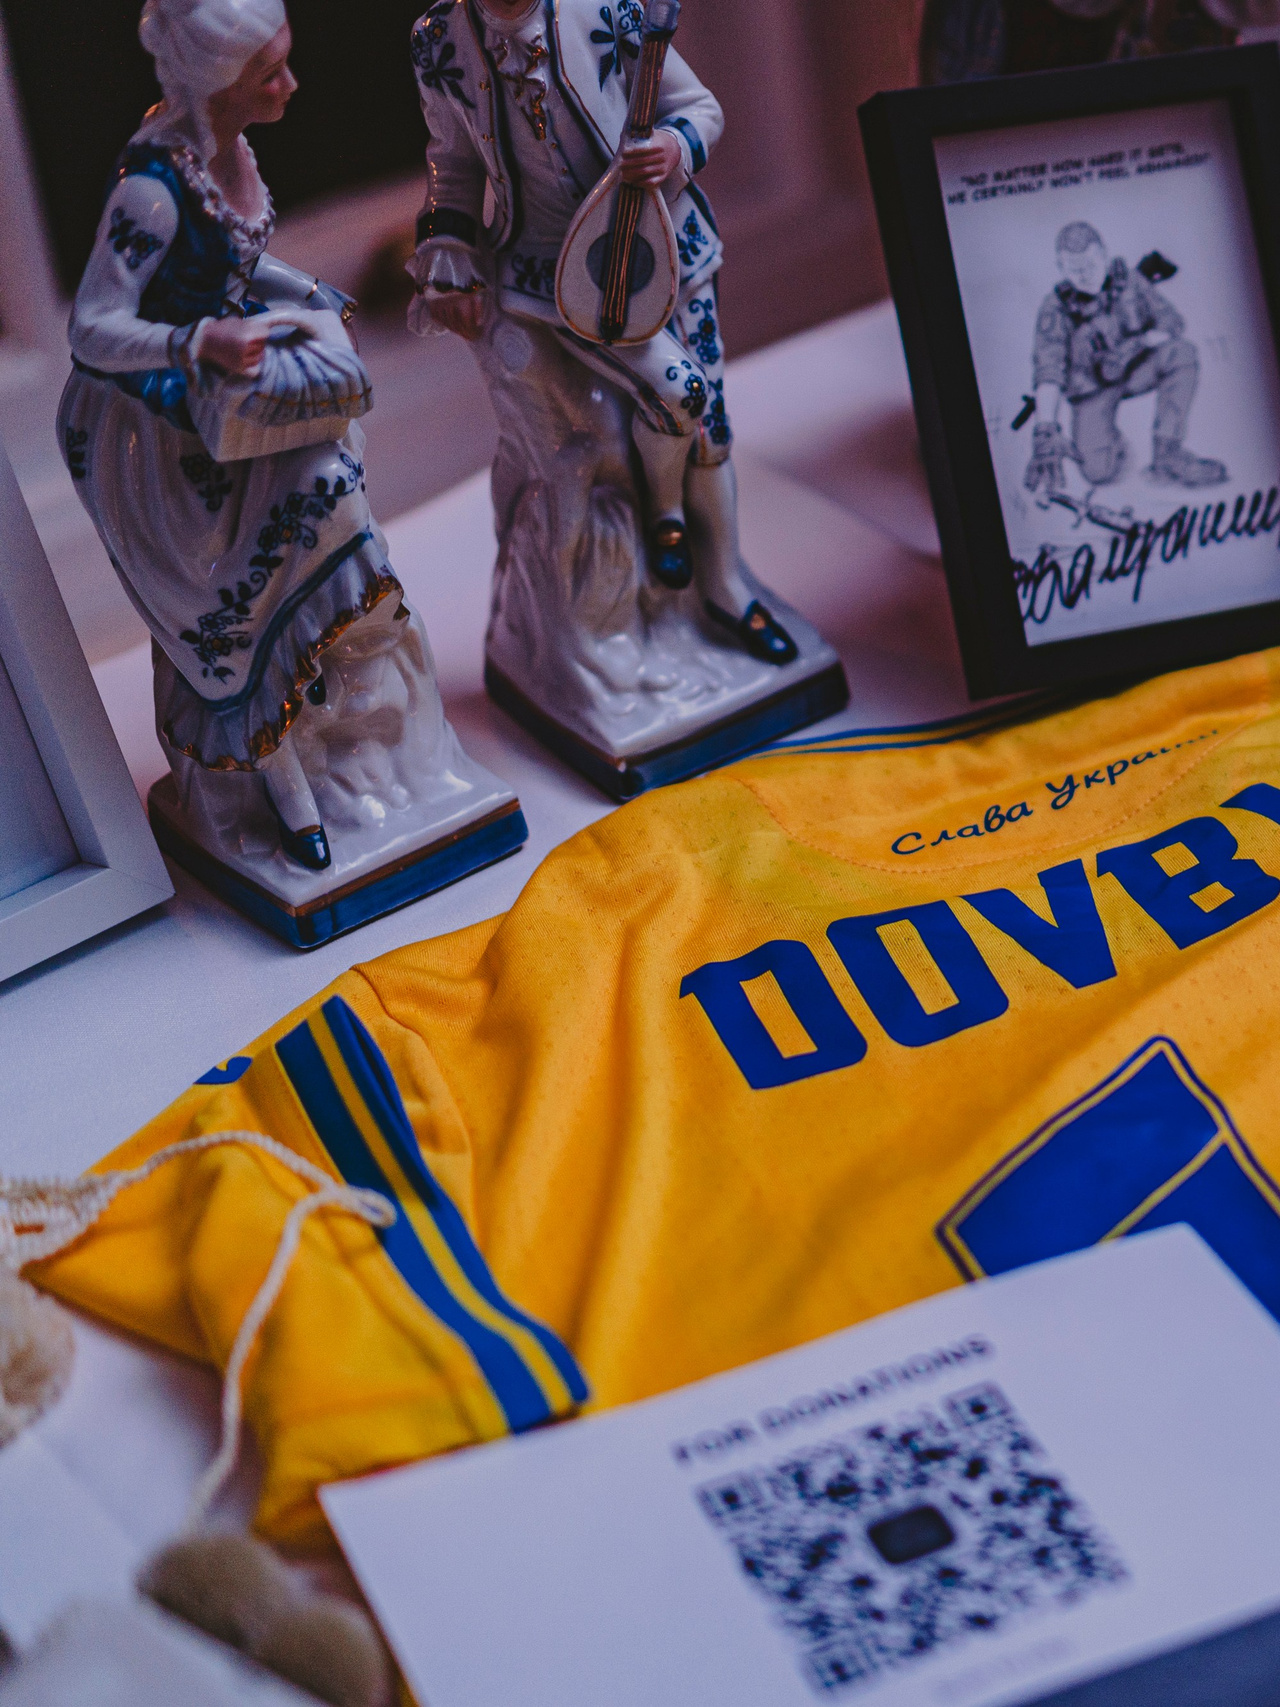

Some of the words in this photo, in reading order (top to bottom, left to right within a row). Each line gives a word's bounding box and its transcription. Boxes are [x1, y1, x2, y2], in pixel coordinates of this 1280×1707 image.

[972, 179, 1045, 201] CERTAINLY
[993, 163, 1047, 182] MATTER
[891, 802, 1034, 856] Слава
[671, 1419, 755, 1469] FOR
[758, 1334, 995, 1441] DONATIONS
